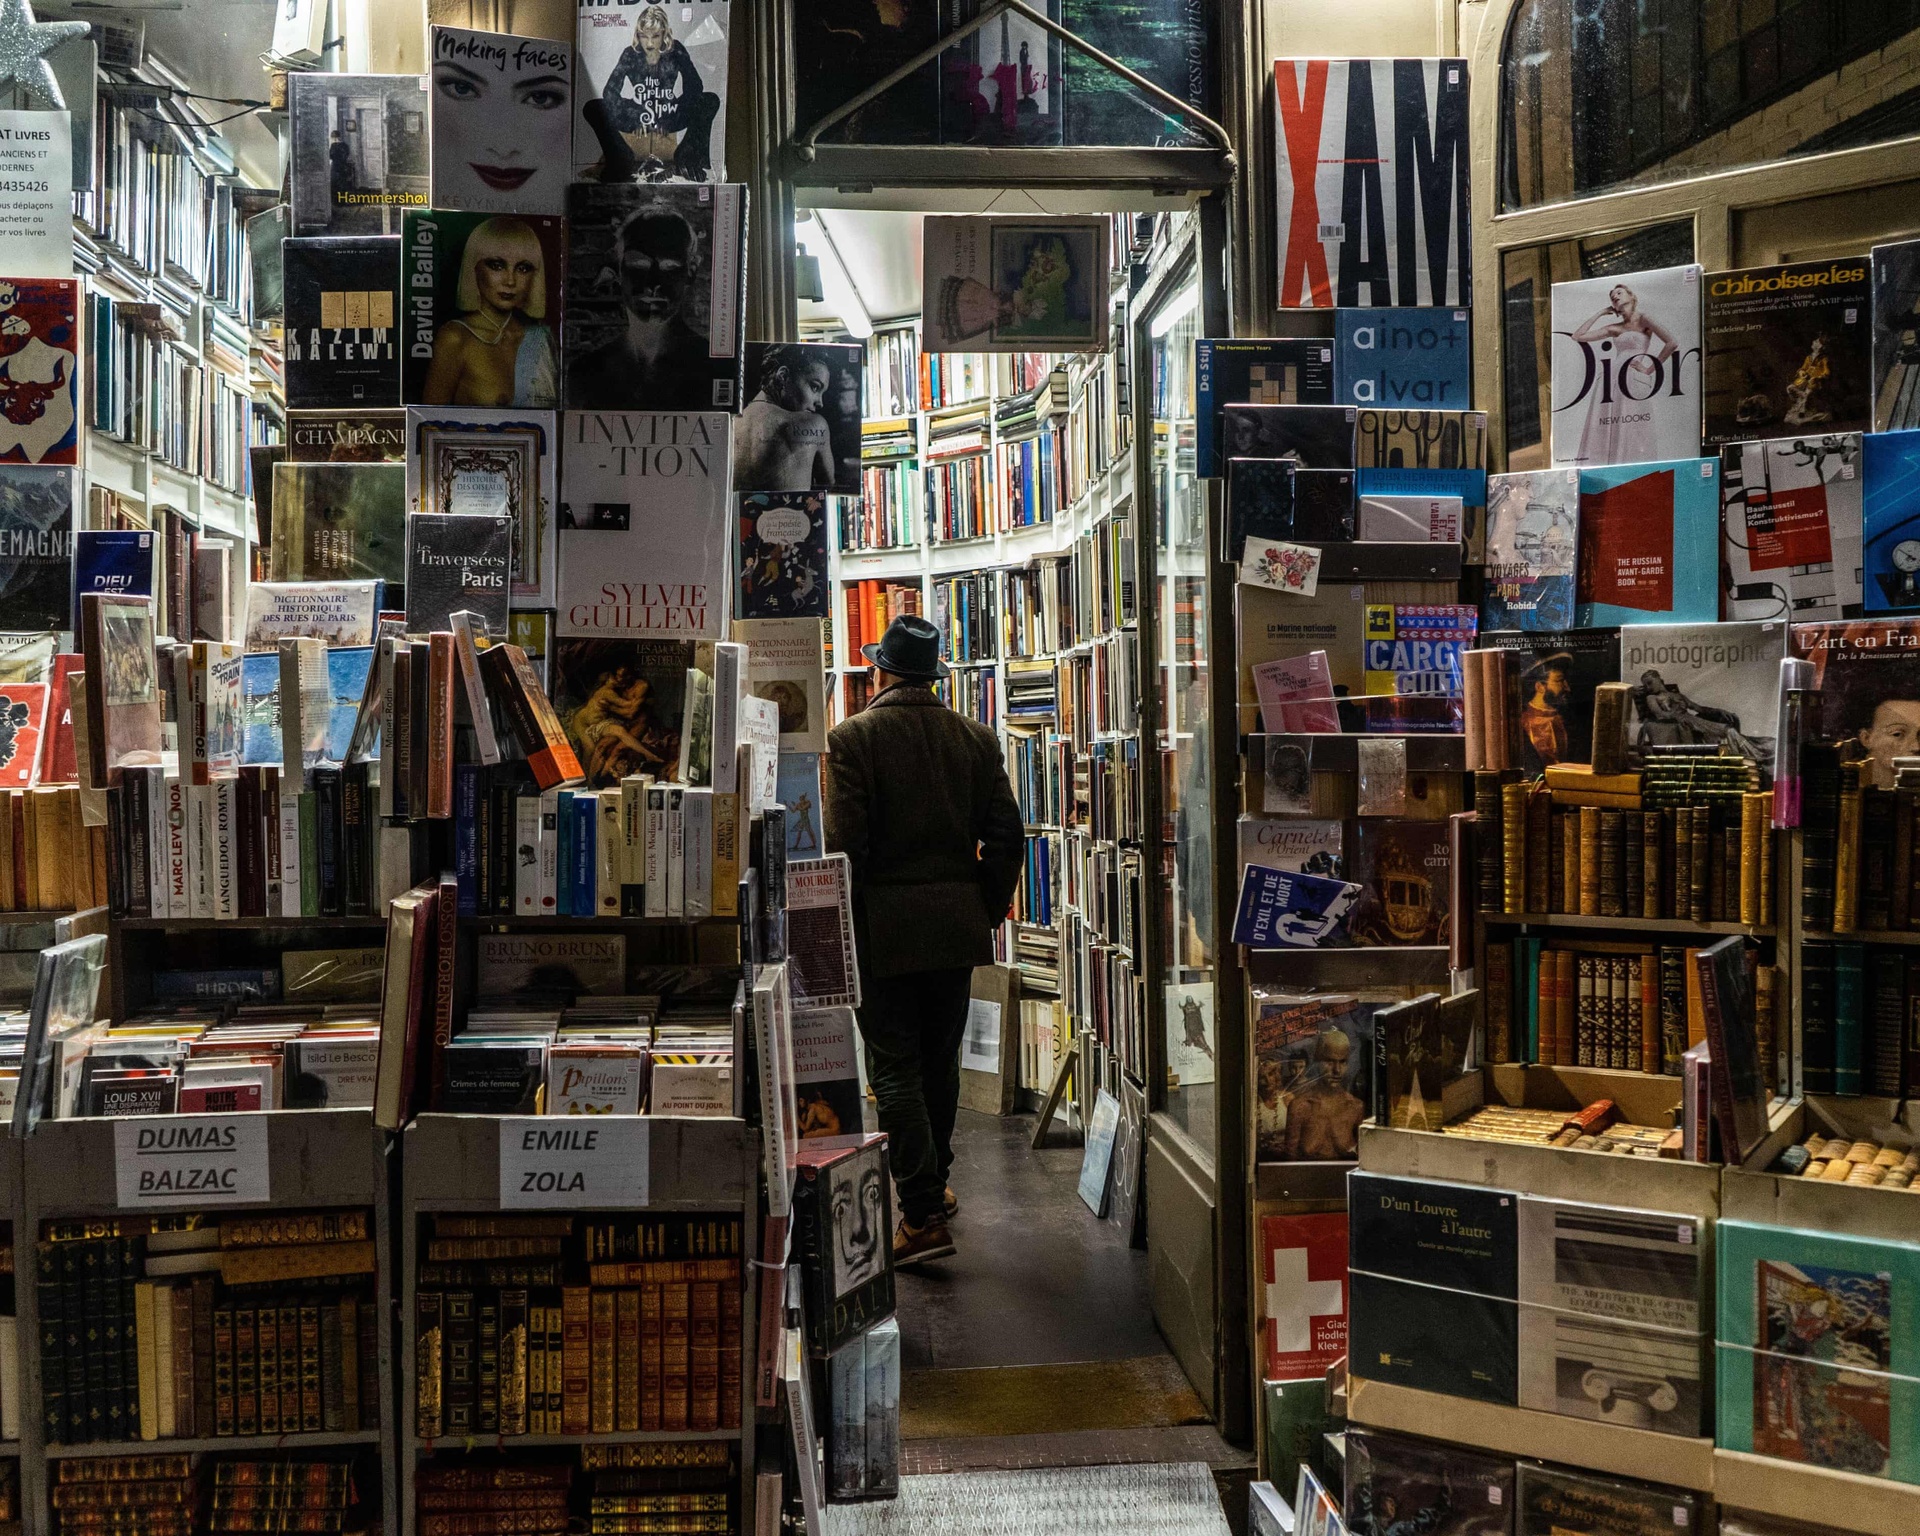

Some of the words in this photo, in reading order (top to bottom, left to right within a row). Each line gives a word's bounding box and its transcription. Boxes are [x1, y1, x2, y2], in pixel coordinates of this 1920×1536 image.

[435, 29, 506, 71] Making
[513, 42, 567, 72] faces
[16, 131, 50, 140] LIVRES
[0, 150, 36, 158] ANCIENS
[38, 150, 48, 158] ET
[13, 202, 54, 210] déplaçons
[337, 192, 428, 204] Hammershøi
[25, 228, 46, 236] livres
[410, 218, 439, 288] Bailey
[1710, 264, 1865, 297] Chinoiseries
[411, 296, 434, 358] David
[1712, 325, 1744, 334] Madeleine
[1200, 375, 1210, 392] De
[1353, 371, 1452, 402] alvar
[1600, 416, 1620, 426] NEW
[1622, 413, 1650, 424] LOOKS
[576, 414, 714, 446] INVITA
[598, 446, 712, 478] -TION
[1746, 500, 1795, 513] Bauhausstil
[1448, 514, 1456, 526] LE
[1747, 512, 1765, 520] oder
[1748, 510, 1824, 527] Konstruktivismus?
[1439, 519, 1447, 530] ET
[417, 548, 506, 568] Traversées
[1618, 558, 1630, 566] THE
[1632, 556, 1662, 565] RUSSIAN
[1618, 566, 1664, 576] AVANT-GARDE
[94, 575, 132, 587] DIEU
[461, 572, 504, 588] Paris
[1618, 578, 1636, 586] BOOK
[274, 595, 348, 604] DICTIONNAIRE
[601, 582, 707, 606] SYLVIE
[278, 605, 342, 614] HISTORIQUE
[1506, 602, 1537, 610] Robida
[263, 614, 280, 622] DES
[284, 614, 309, 622] RUES
[312, 614, 325, 622] DE
[328, 614, 356, 622] PARIS
[570, 604, 707, 630] GUILLEM
[1267, 624, 1275, 632] La
[1277, 624, 1301, 632] Marine
[1304, 624, 1337, 632] nationale
[747, 638, 811, 648] DICTIONNAIRE
[1801, 630, 1846, 649] L'art
[1855, 632, 1876, 648] en
[762, 648, 816, 658] ANTIQUITÉS
[1836, 652, 1848, 660] De
[1850, 652, 1858, 660] la
[219, 666, 240, 684] TRAIN
[1399, 672, 1456, 697] CULT
[385, 687, 393, 748] Monet-Rodin
[195, 737, 205, 757] 30
[218, 783, 228, 831] ROMAN
[648, 813, 656, 850] Modiano
[172, 825, 183, 857] LEVY
[218, 832, 230, 914] LANGUEDOC
[648, 854, 657, 882] Patrick
[173, 858, 183, 896] MARC
[795, 874, 835, 889] MOURRE
[1265, 874, 1279, 890] DE
[1261, 890, 1274, 906] ET
[1275, 876, 1293, 908] MORT
[1253, 906, 1271, 942] D'EXIL
[486, 942, 553, 956] BRUNO
[557, 941, 618, 956] BRUNI
[436, 947, 452, 1046] FIORENTINO
[307, 1052, 326, 1064] Isild
[328, 1052, 342, 1063] Le
[344, 1052, 376, 1063] Besco
[338, 1076, 355, 1084] DIRE
[451, 1080, 476, 1088] Crimes
[478, 1080, 489, 1088] de
[490, 1080, 520, 1088] femmes
[104, 1092, 138, 1104] LOUIS
[140, 1091, 161, 1102] XVII
[138, 1126, 236, 1149] DUMAS
[522, 1130, 598, 1150] EMILE
[139, 1168, 237, 1191] BALZAC
[520, 1172, 585, 1192] ZOLA
[1380, 1196, 1411, 1213] D'un
[1414, 1200, 1458, 1218] Louvre
[1441, 1220, 1449, 1233] à
[1452, 1220, 1492, 1239] l'autre
[1318, 1341, 1338, 1350] Klee
